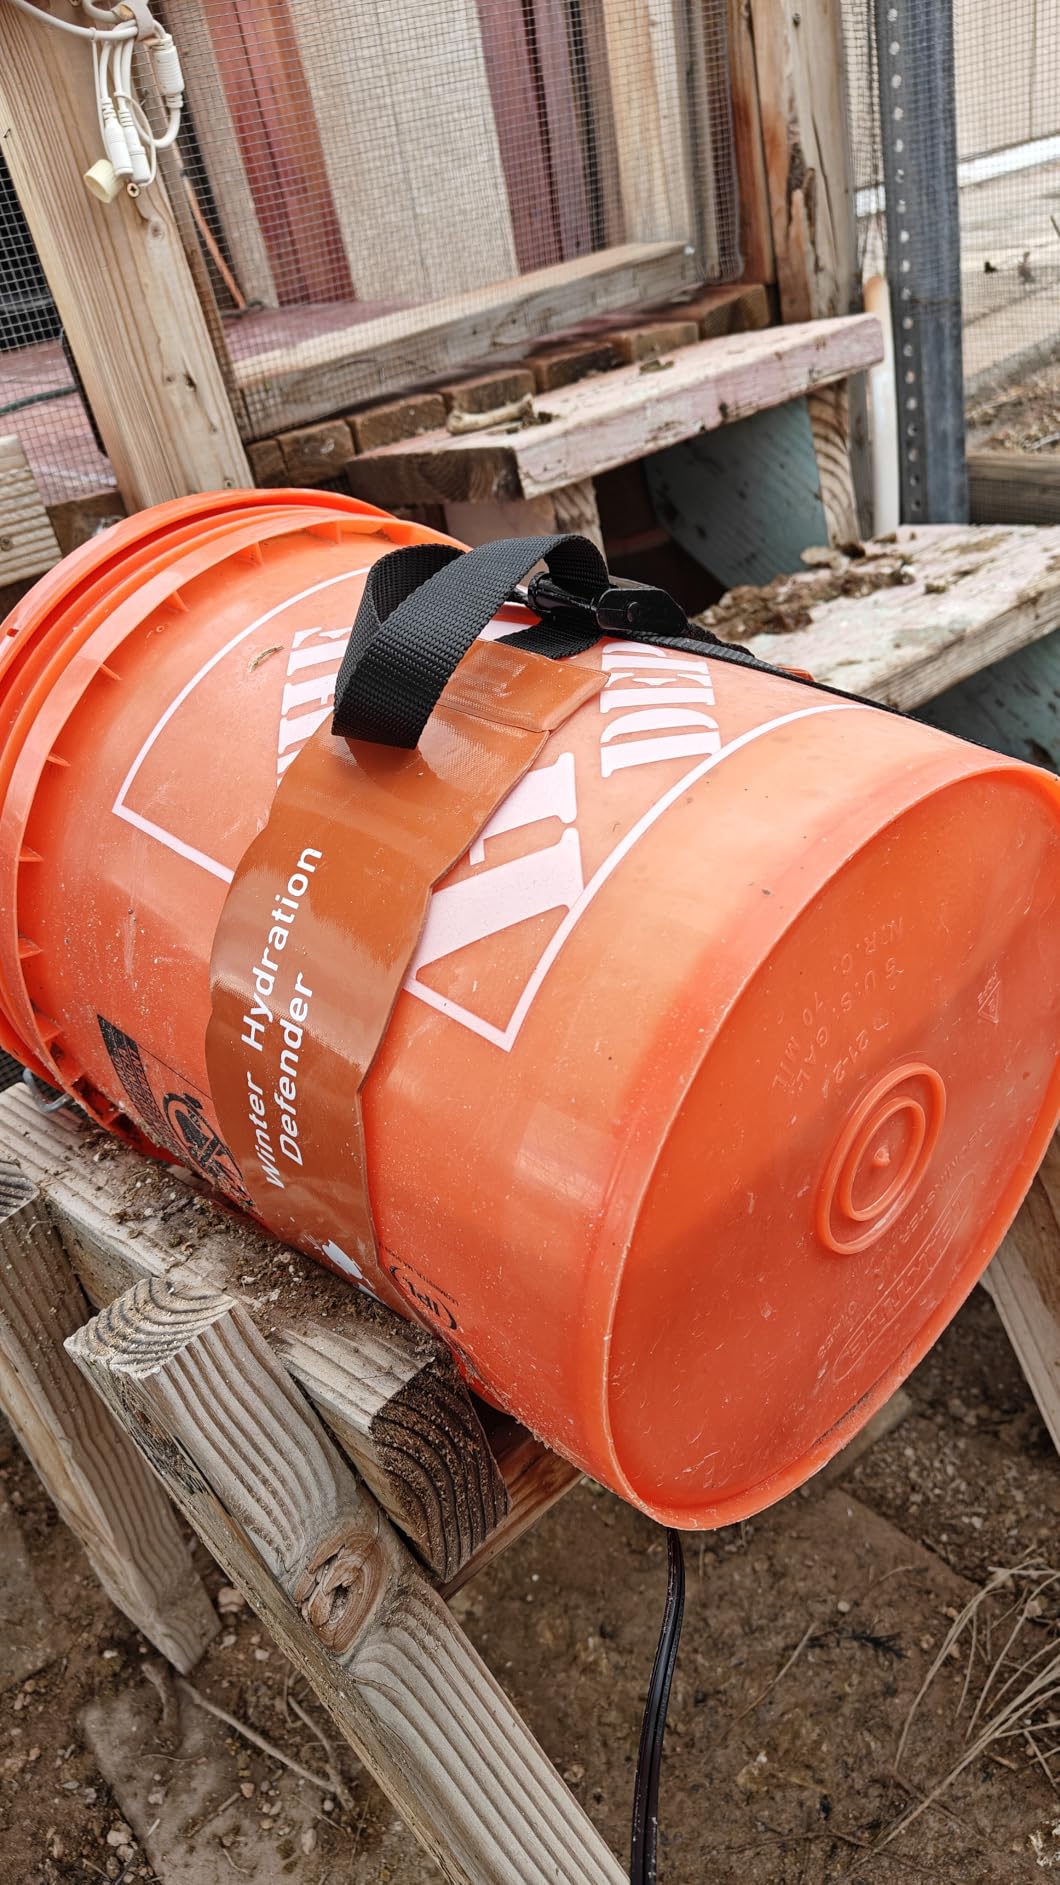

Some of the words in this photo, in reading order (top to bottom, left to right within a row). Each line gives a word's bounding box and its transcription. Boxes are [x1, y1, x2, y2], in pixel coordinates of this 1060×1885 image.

[241, 847, 322, 1052] Hydration
[246, 1071, 285, 1190] Winter
[273, 971, 313, 1167] Defender
